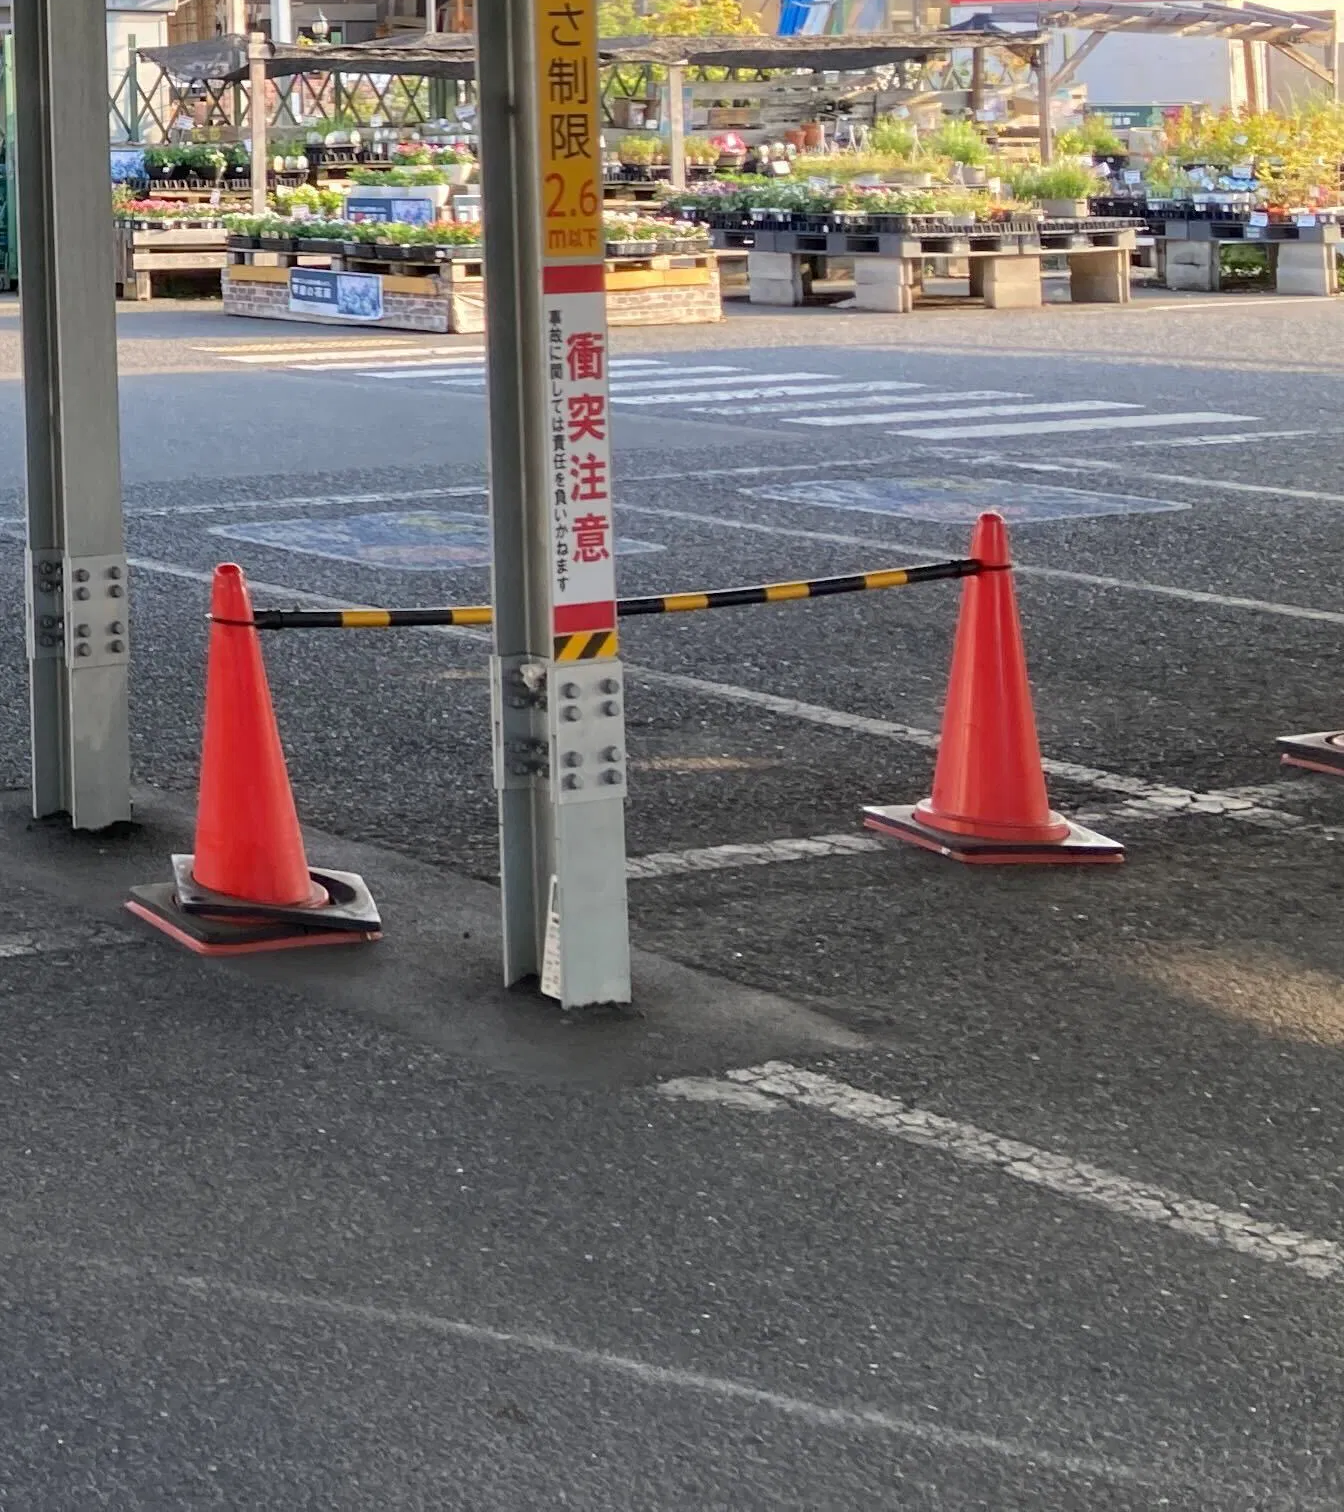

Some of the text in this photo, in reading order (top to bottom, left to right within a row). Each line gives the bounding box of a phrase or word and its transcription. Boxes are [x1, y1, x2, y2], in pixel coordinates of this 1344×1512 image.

[544, 171, 598, 218] 2.6
[548, 228, 597, 250] m以下
[566, 331, 610, 564] 衝突注意
